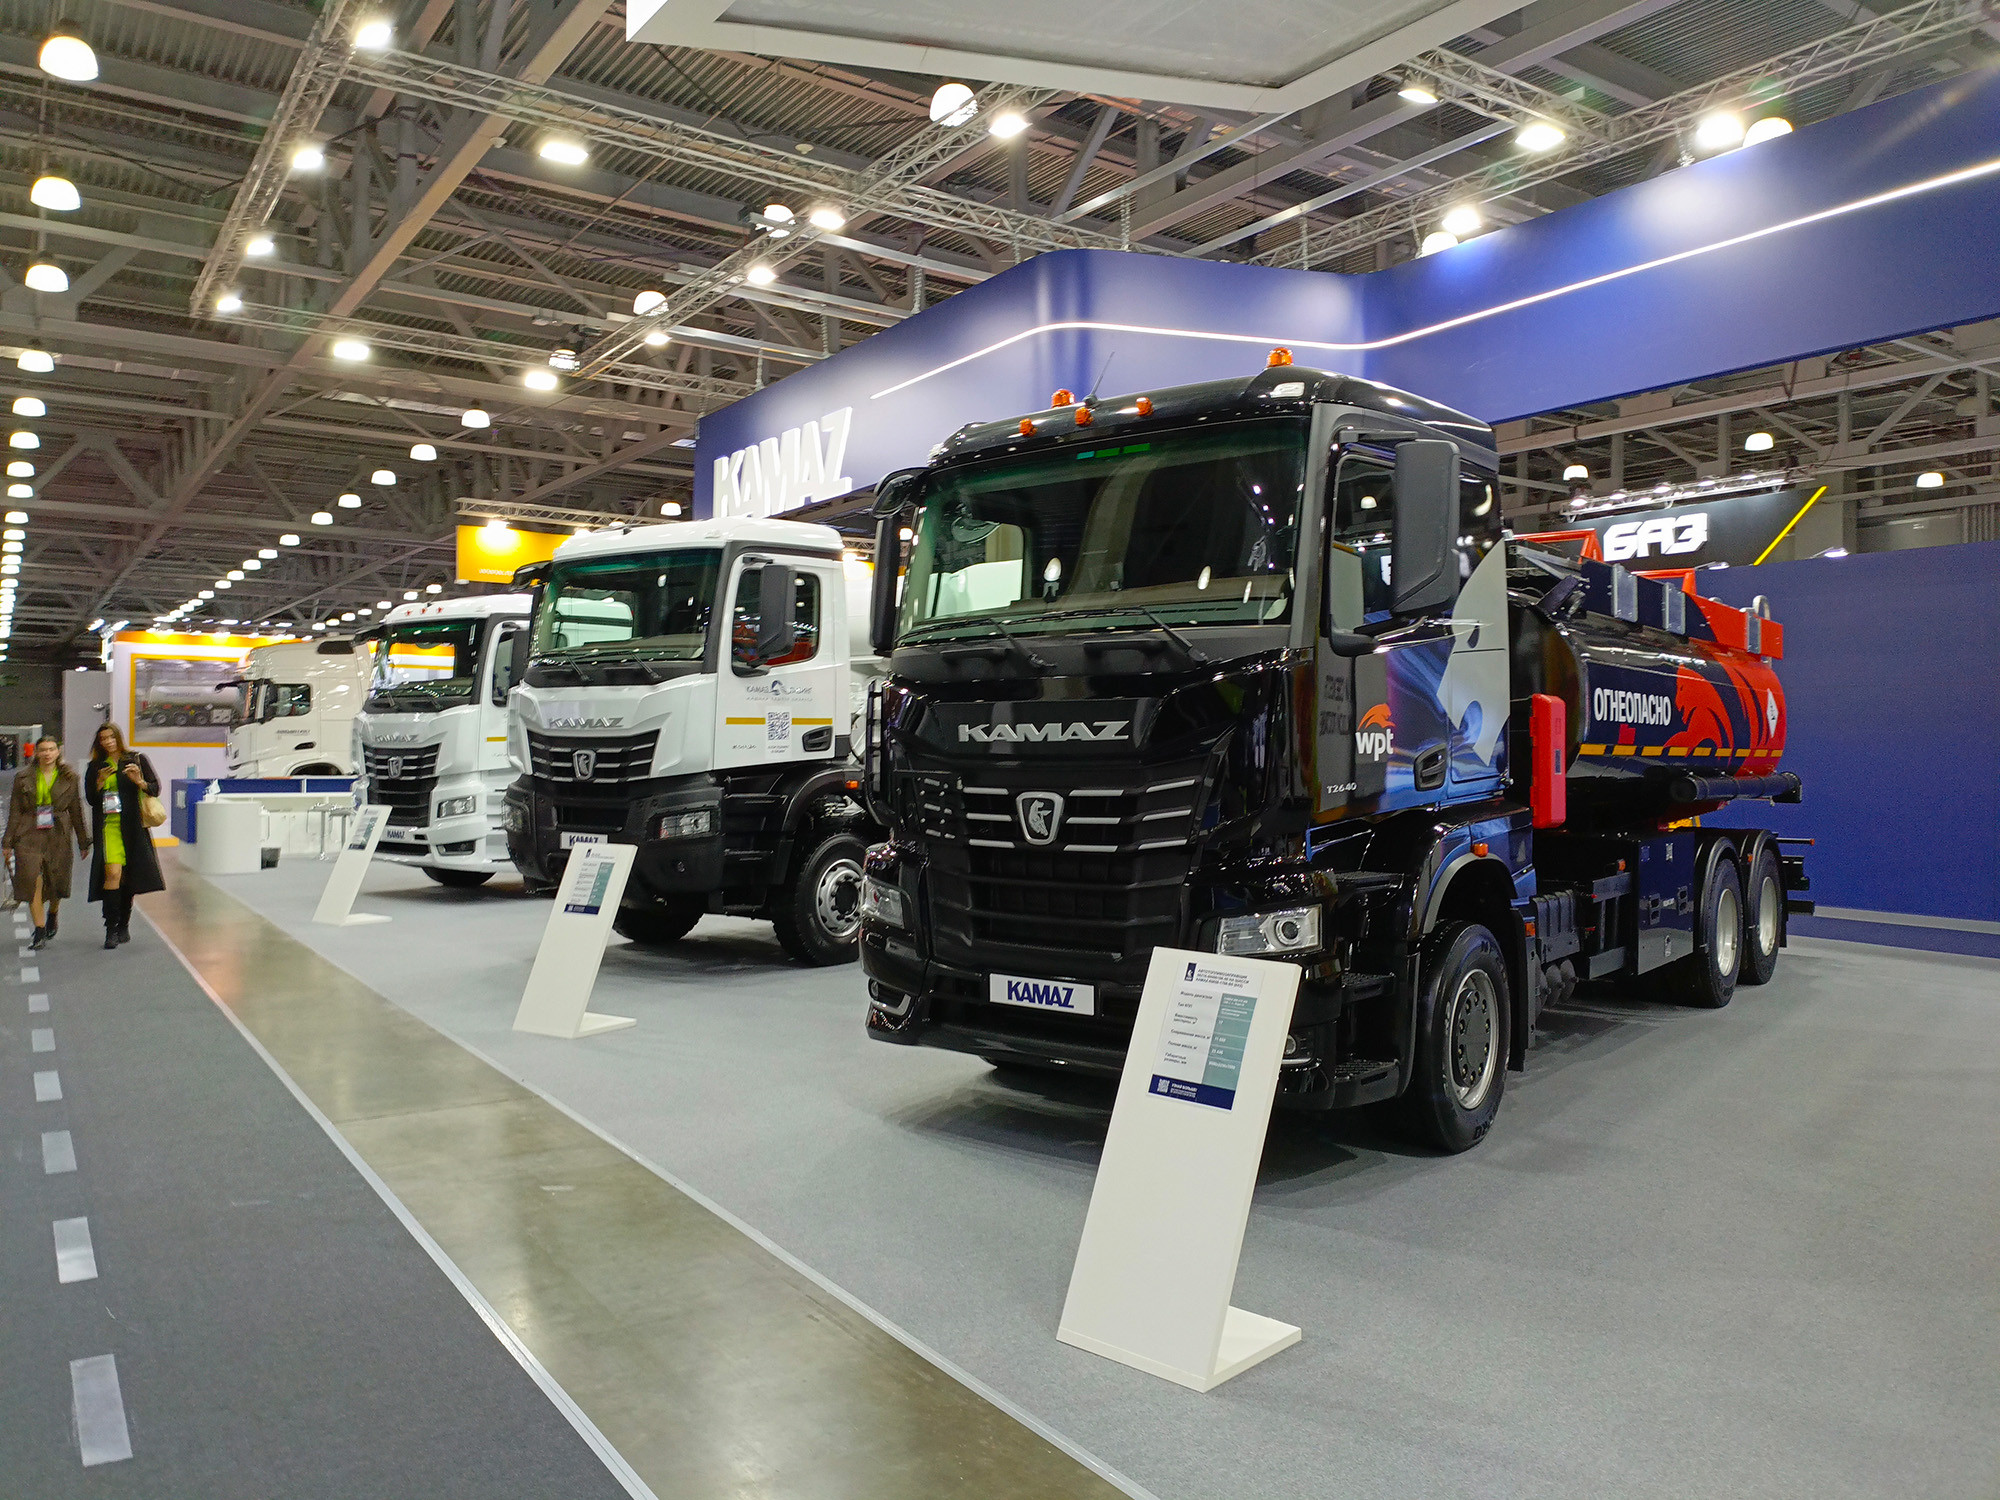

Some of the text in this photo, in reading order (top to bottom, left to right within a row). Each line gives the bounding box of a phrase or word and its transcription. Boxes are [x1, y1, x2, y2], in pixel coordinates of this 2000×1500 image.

[713, 406, 853, 519] KAMAZ
[1603, 512, 1708, 562] БАЗ
[548, 716, 625, 729] KAMAZ
[1593, 686, 1672, 727] ОГНЕОПАСНО
[957, 720, 1130, 743] KAMAZ
[1355, 727, 1395, 762] wpt
[1007, 979, 1075, 1009] KAMAZ
